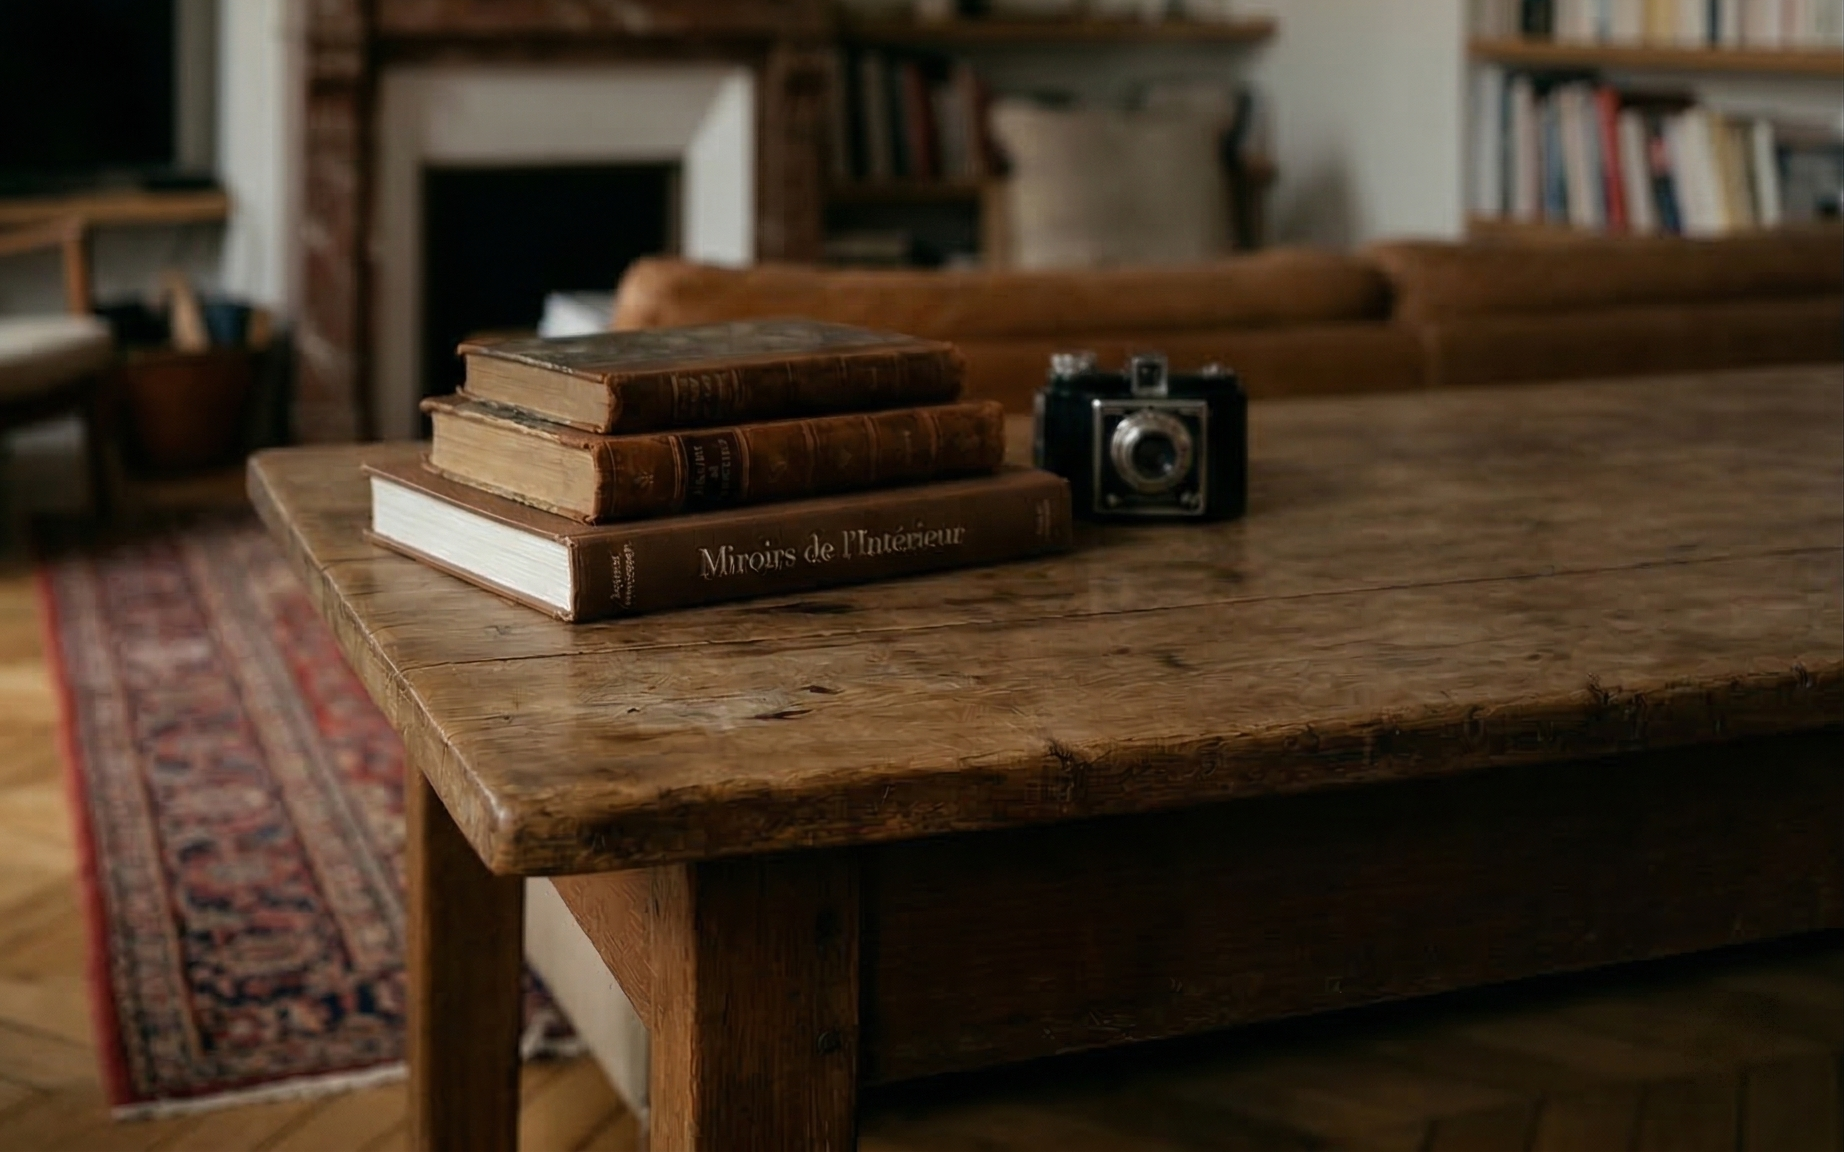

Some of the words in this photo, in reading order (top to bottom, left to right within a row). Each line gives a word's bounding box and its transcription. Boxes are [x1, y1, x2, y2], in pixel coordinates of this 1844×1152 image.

[699, 540, 797, 580] Miroirs
[804, 532, 837, 564] de
[841, 522, 966, 558] l'Intérieur
